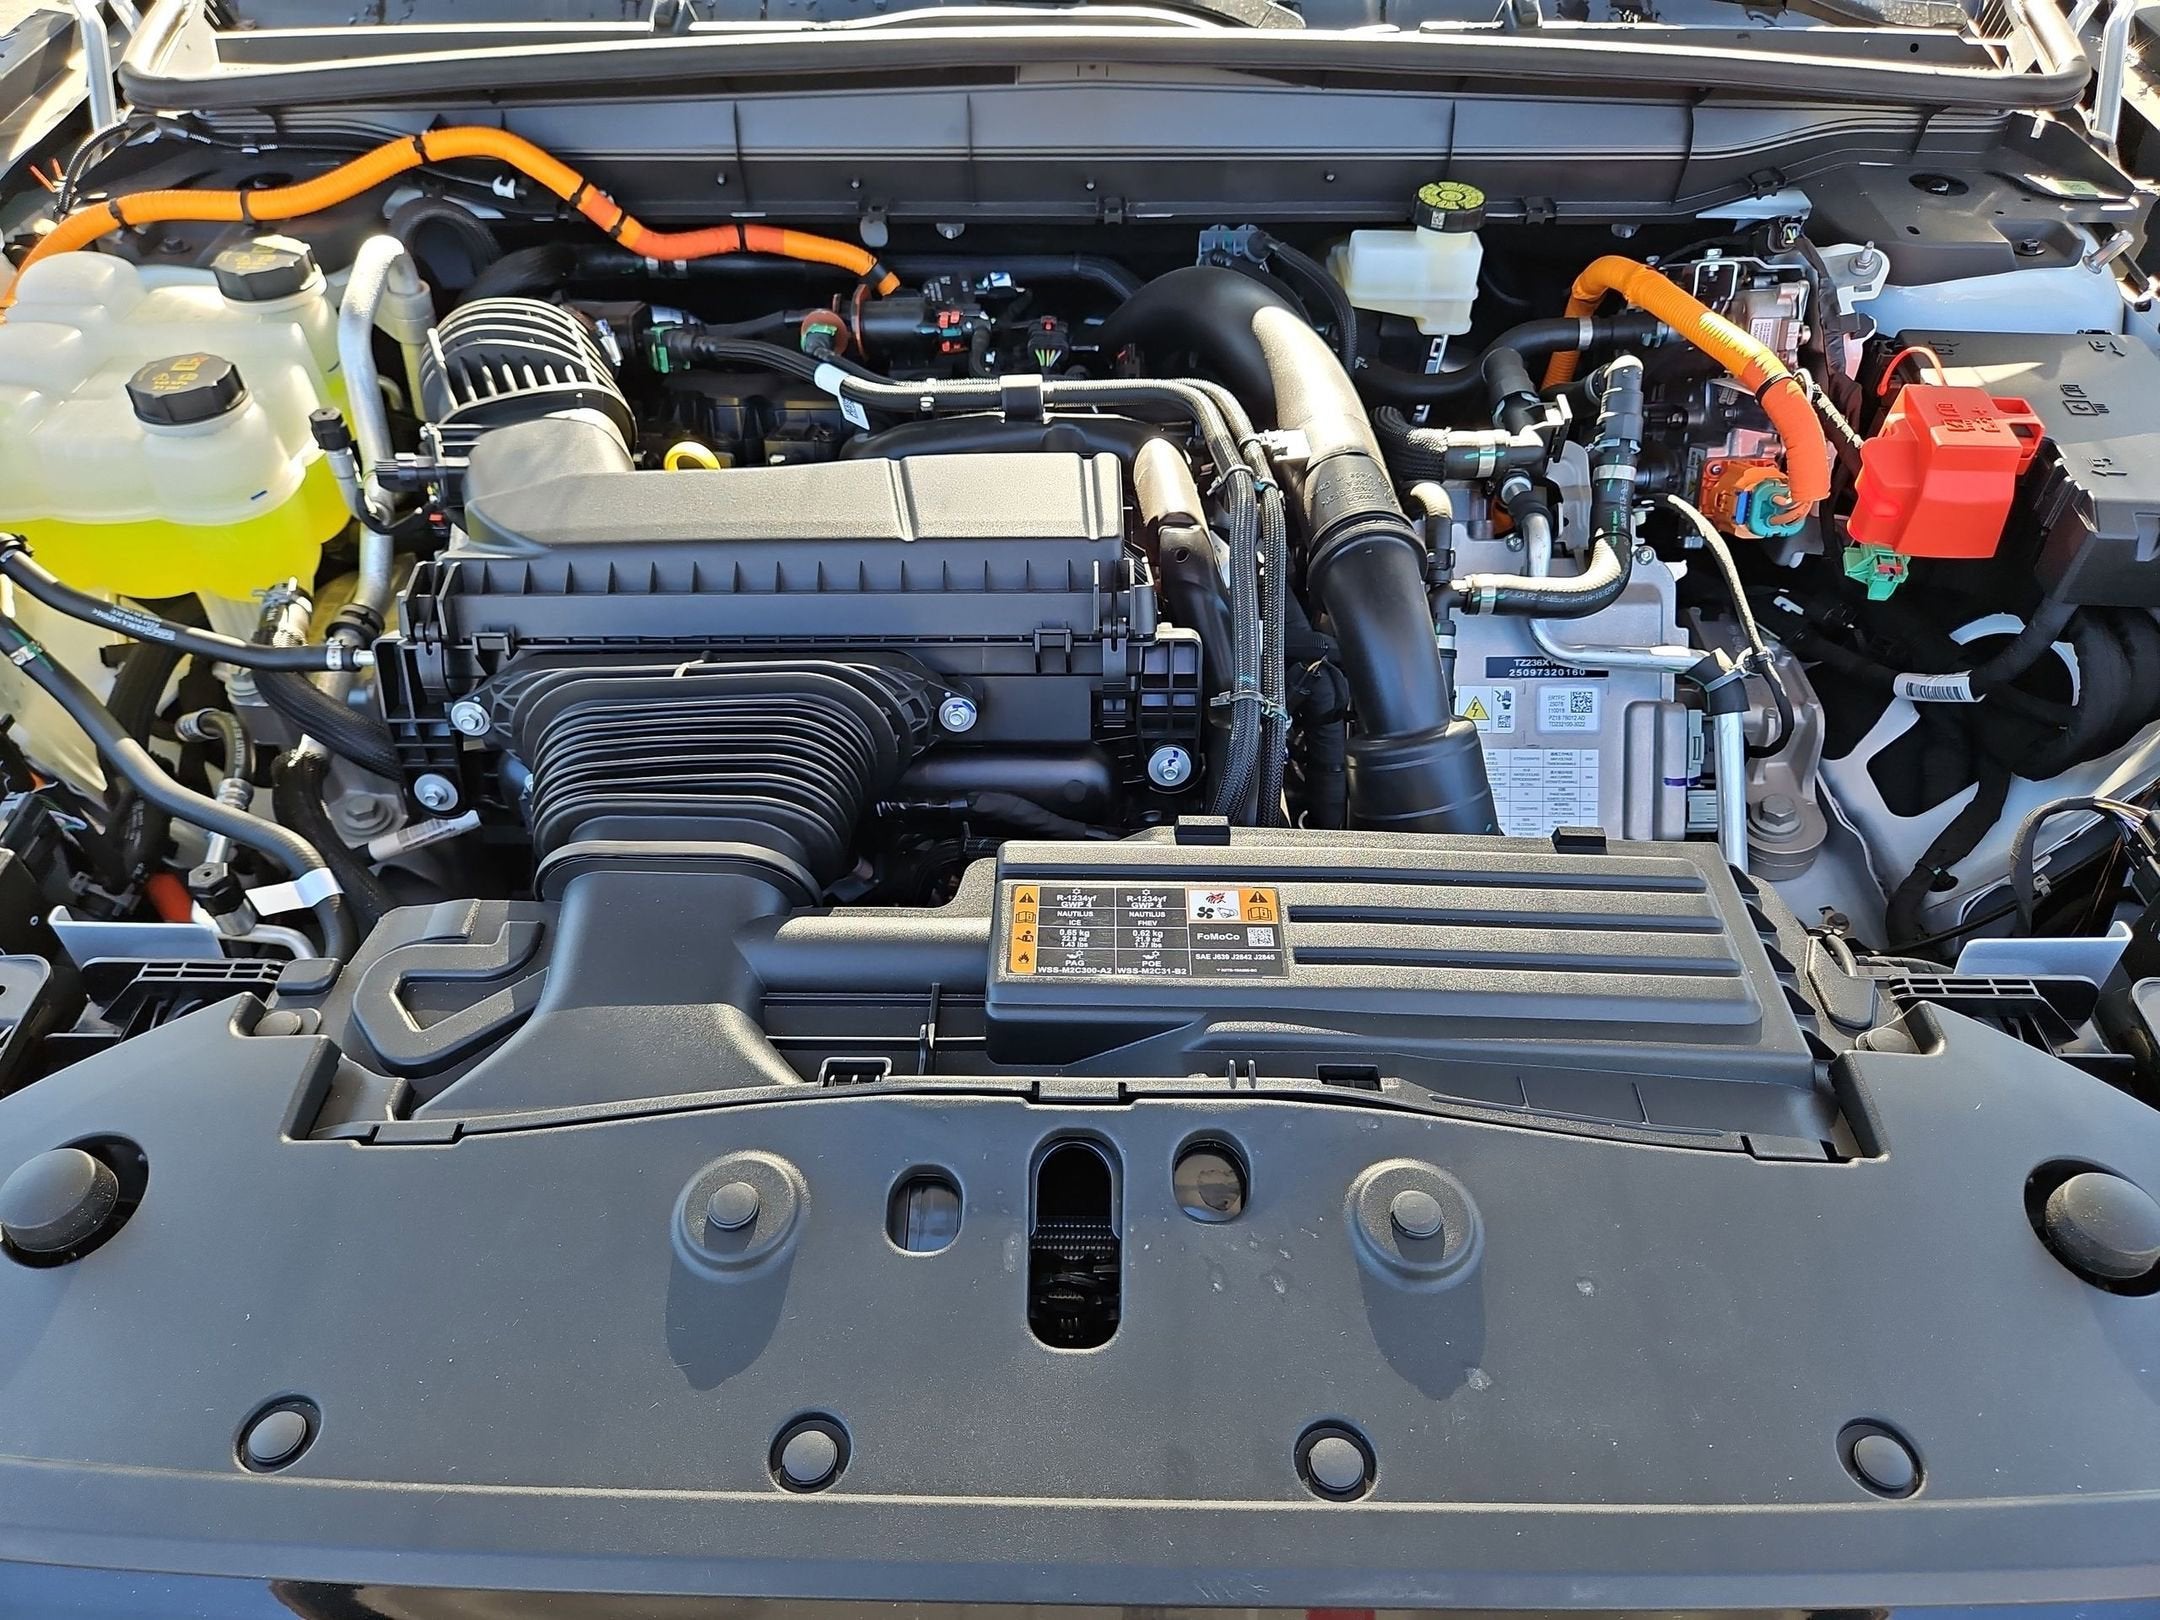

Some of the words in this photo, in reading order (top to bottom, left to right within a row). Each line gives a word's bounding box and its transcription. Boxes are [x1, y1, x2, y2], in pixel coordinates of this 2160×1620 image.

[1509, 668, 1586, 677] 25097320160
[1056, 894, 1097, 903] R-1234yf
[1126, 895, 1167, 903] R-1234yf
[1079, 929, 1090, 938] kg
[1152, 930, 1164, 939] kg
[1197, 932, 1240, 941] FoMoCo
[1038, 966, 1112, 974] WSS-M2C300-A2
